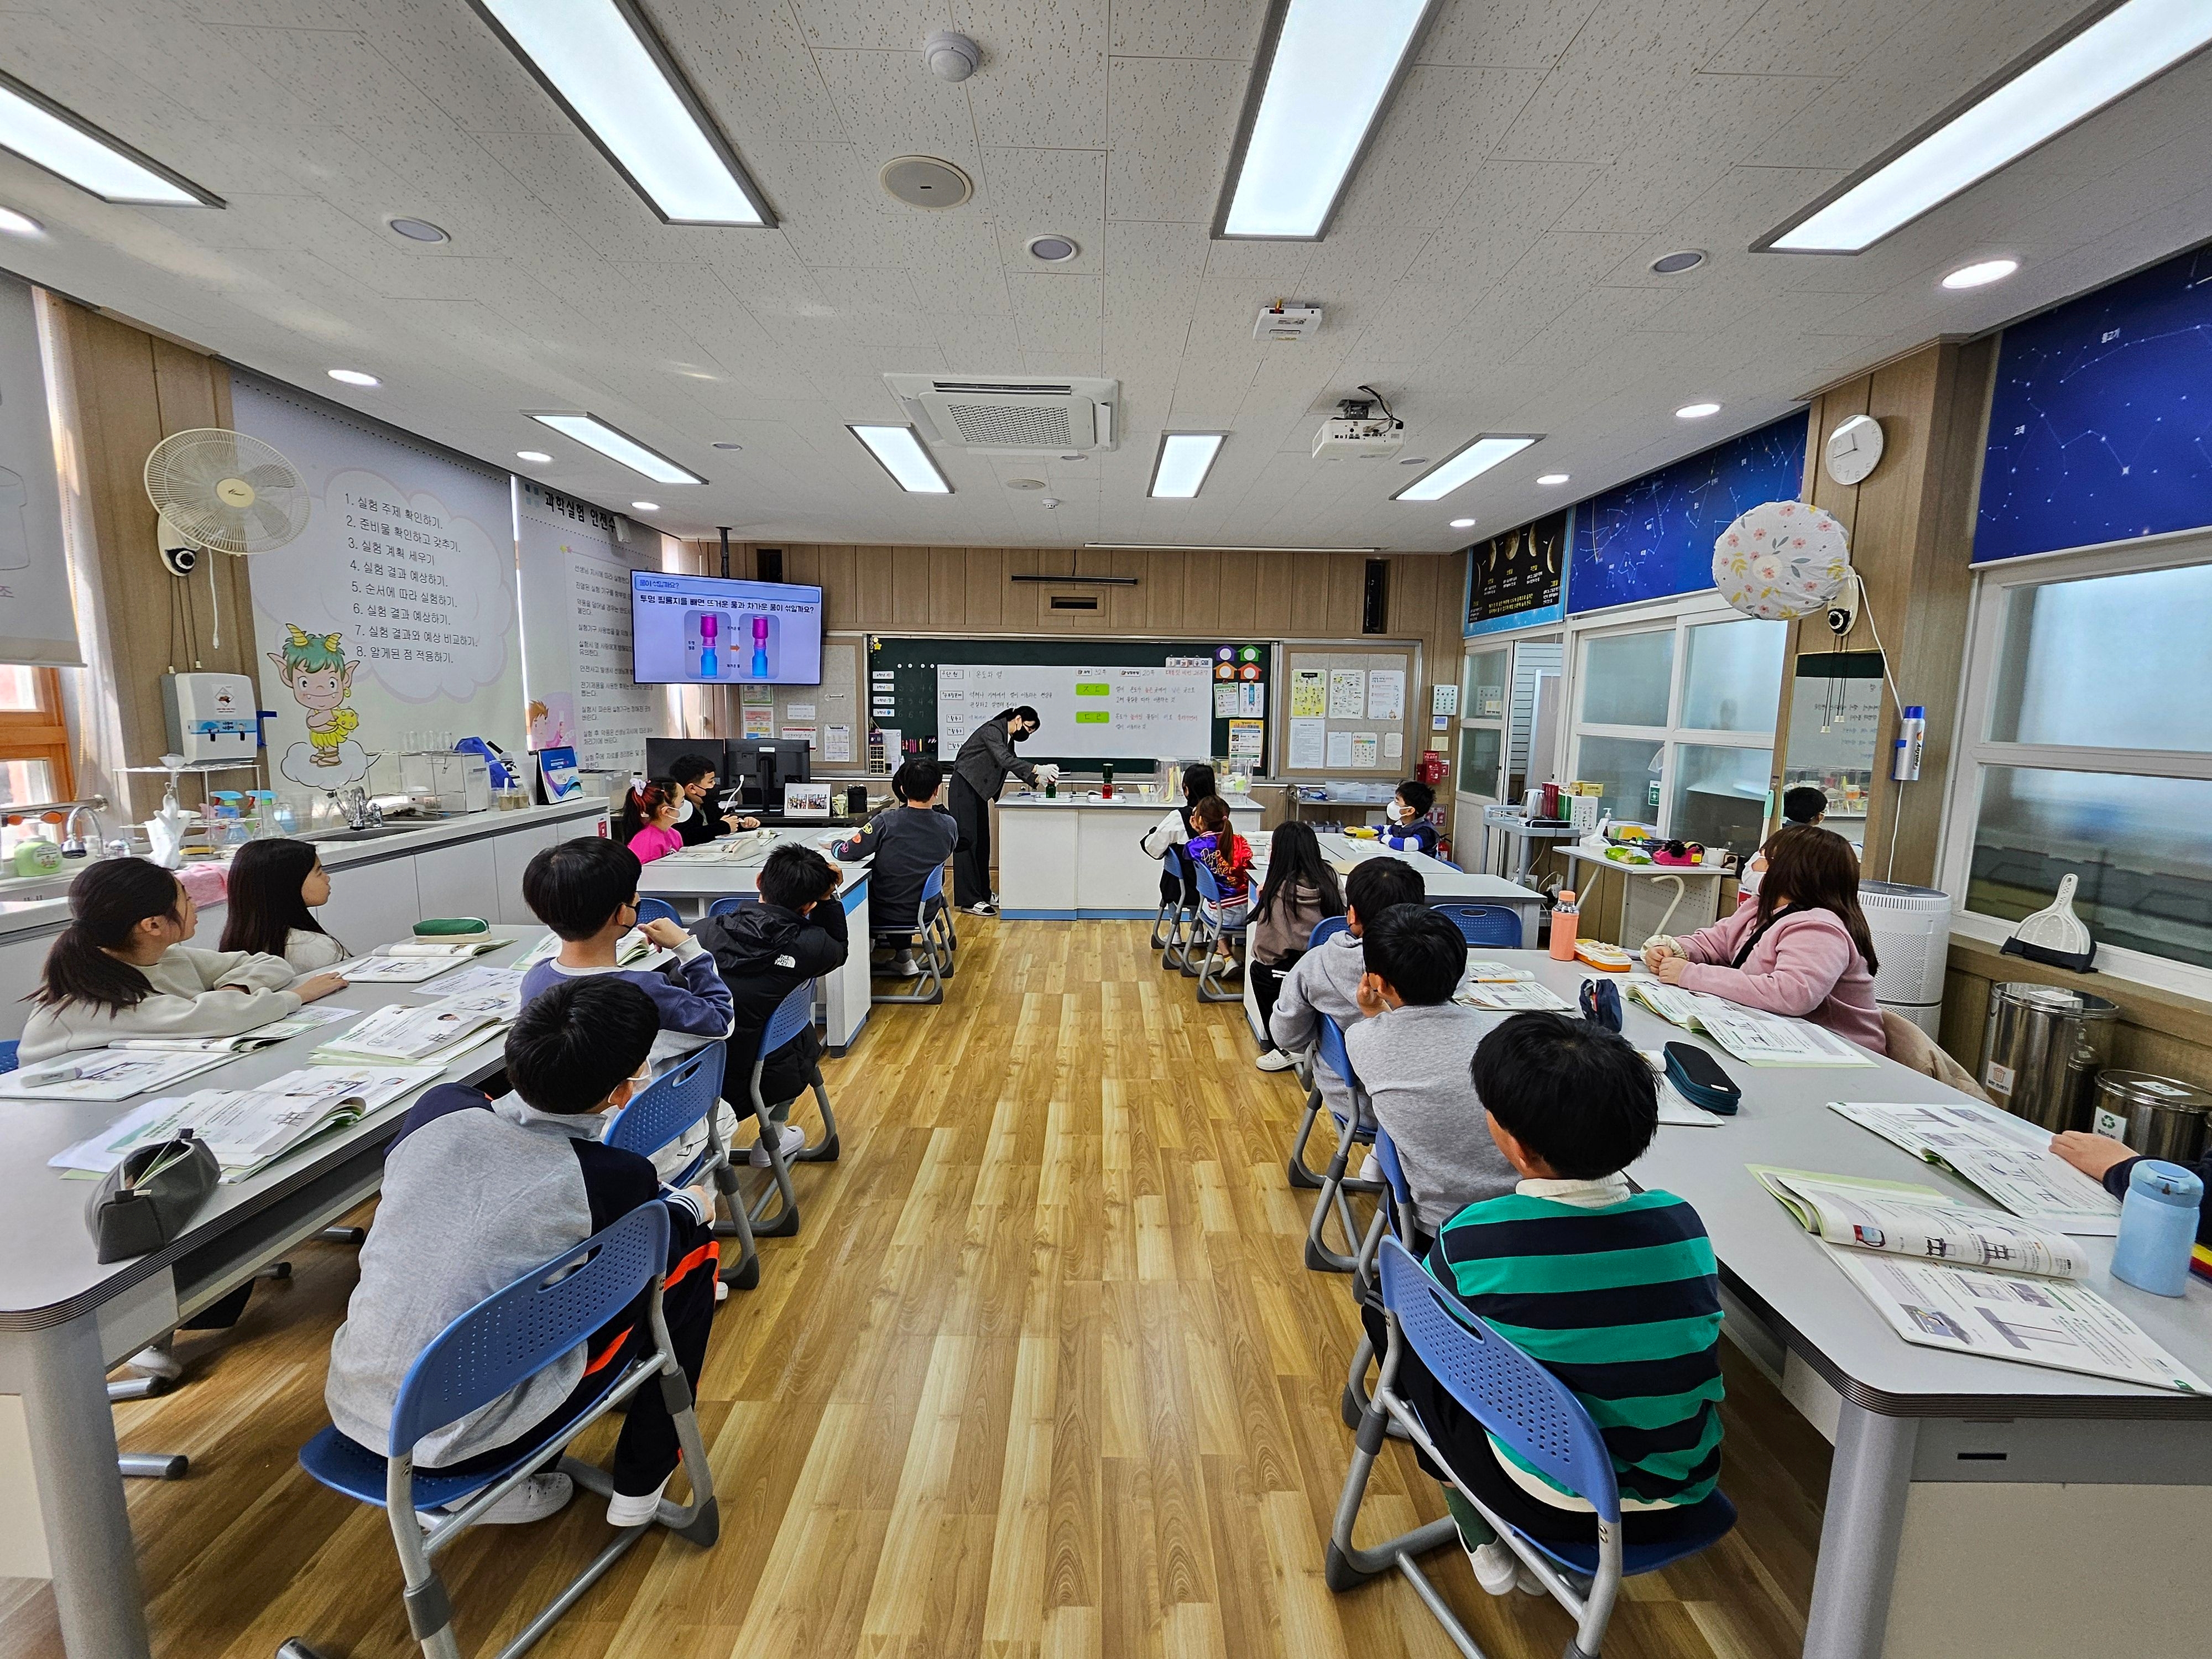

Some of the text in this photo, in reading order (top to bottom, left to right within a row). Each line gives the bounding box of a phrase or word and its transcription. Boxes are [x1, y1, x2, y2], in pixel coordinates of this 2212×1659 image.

[358, 497, 378, 512] 실험
[382, 503, 401, 518] 주제
[405, 509, 443, 529] 확인하기.
[544, 491, 616, 533] 과학실험 안전수
[359, 518, 390, 536] 준비물
[394, 526, 431, 545] 확인하고
[434, 536, 461, 552] 갖추기.
[361, 540, 382, 555] 실험
[385, 544, 404, 560] 계획
[409, 551, 435, 566] 세우기
[363, 561, 383, 576] 실험
[387, 565, 406, 580] 결과
[410, 570, 448, 587] 예상하기.
[365, 583, 395, 598] 순서에
[399, 588, 417, 601] 따라
[420, 591, 457, 608] 실험하기.
[640, 594, 656, 604] 투명
[658, 596, 687, 606] 필름지를
[690, 598, 705, 607] 빼면
[707, 599, 729, 609] 뜨거운
[731, 601, 745, 609] 물과
[747, 602, 768, 611] 차가운
[770, 604, 783, 612] 물이
[367, 604, 387, 618] 실험
[391, 607, 409, 620] 결과
[414, 611, 451, 625] 예상하기.
[369, 625, 388, 638] 실험
[392, 628, 420, 641] 결과와
[424, 630, 441, 644] 예상
[444, 634, 478, 647] 비교하기.
[371, 646, 400, 660] 알게된
[404, 649, 413, 661] 점
[416, 650, 453, 663] 적용하기.
